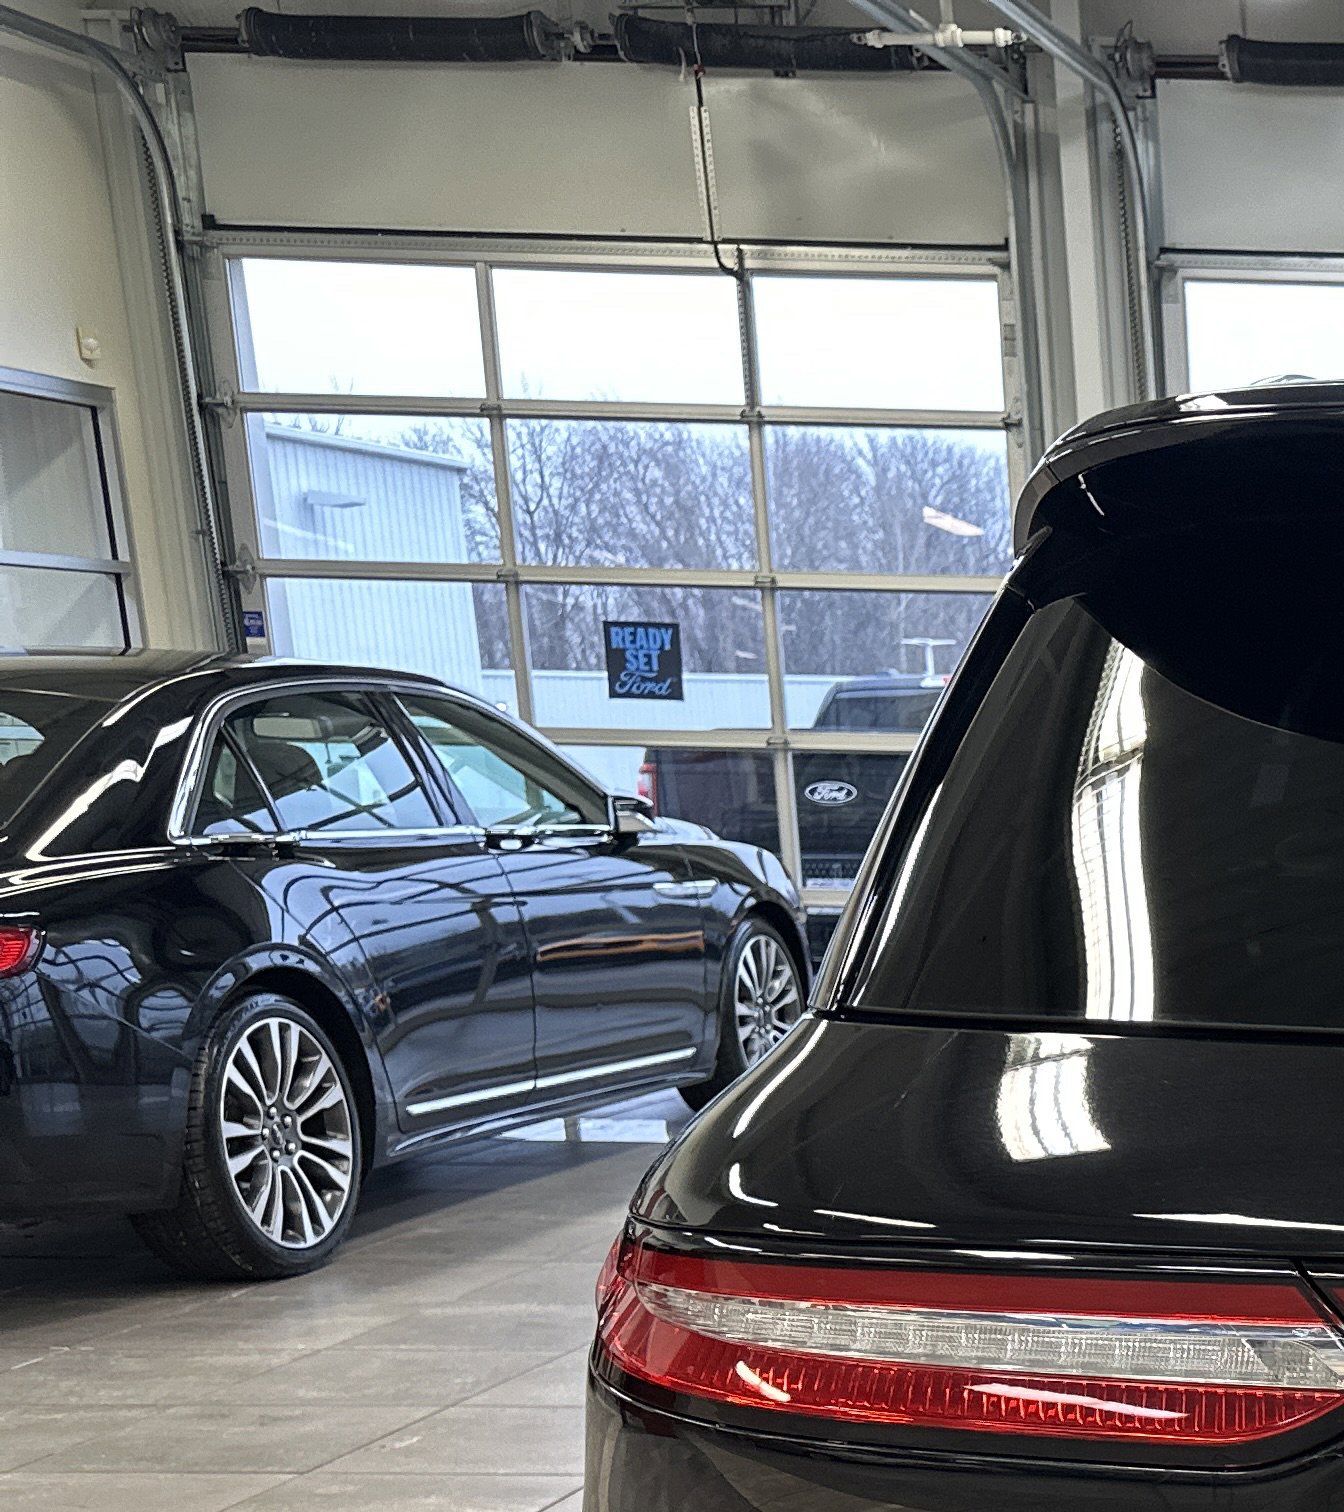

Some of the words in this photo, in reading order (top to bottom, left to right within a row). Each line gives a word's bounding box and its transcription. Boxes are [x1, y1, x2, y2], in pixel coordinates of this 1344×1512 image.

[610, 627, 672, 651] READY
[625, 650, 660, 671] SET
[615, 671, 672, 695] Ford
[812, 784, 848, 800] Ford
